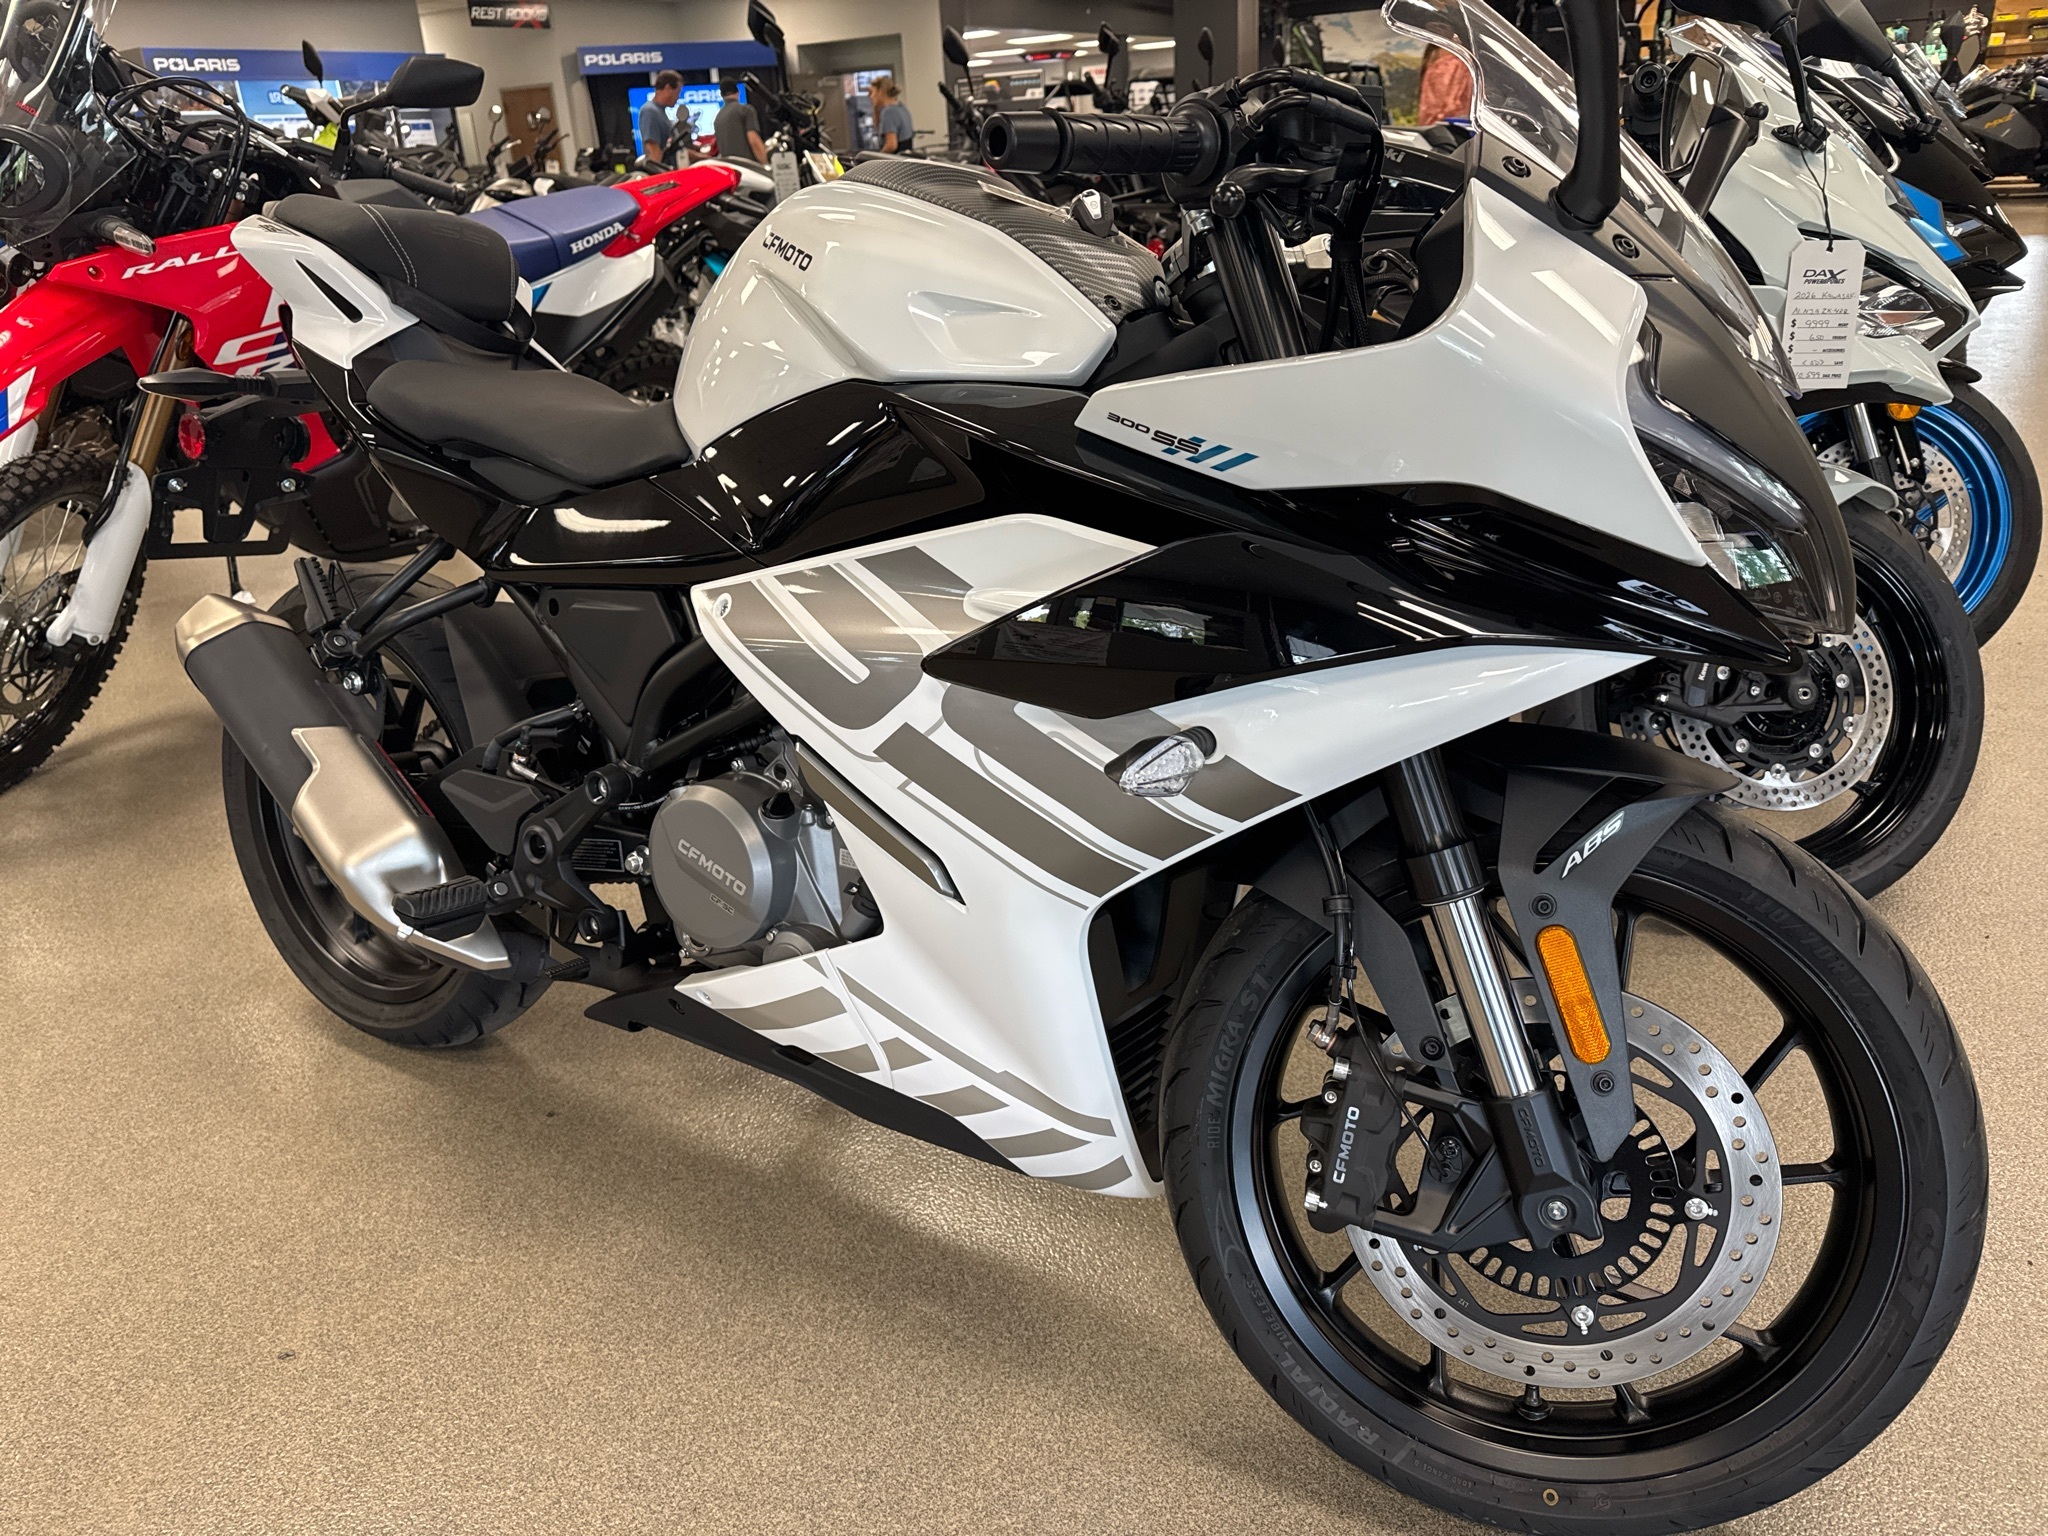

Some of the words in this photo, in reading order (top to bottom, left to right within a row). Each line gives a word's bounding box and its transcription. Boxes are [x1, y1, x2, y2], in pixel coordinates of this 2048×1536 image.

[471, 7, 502, 20] REST
[506, 7, 549, 21] ROOMS
[153, 57, 241, 72] POLARIS
[584, 51, 663, 67] POLARIS
[569, 221, 626, 255] HONDA
[762, 231, 813, 272] CFMOTO
[1803, 268, 1848, 280] DAX
[1794, 291, 1817, 299] 2026
[1789, 331, 1795, 341] $
[1790, 318, 1797, 328] $
[1787, 344, 1794, 354] $
[1107, 411, 1150, 434] 300
[1151, 430, 1202, 455] SS
[1561, 810, 1625, 879] ABS
[677, 838, 747, 896] CFMOTO
[1206, 1020, 1246, 1108] MIGRA
[1207, 1116, 1221, 1149] RIDE
[1332, 1106, 1360, 1184] CFMOTO
[1517, 1107, 1545, 1169] CFMOTO
[1245, 1274, 1293, 1350] TUBELESS
[1280, 1351, 1380, 1446] RADIAL
[1422, 1463, 1448, 1480] RANGE
[1451, 1476, 1472, 1489] LOAD
